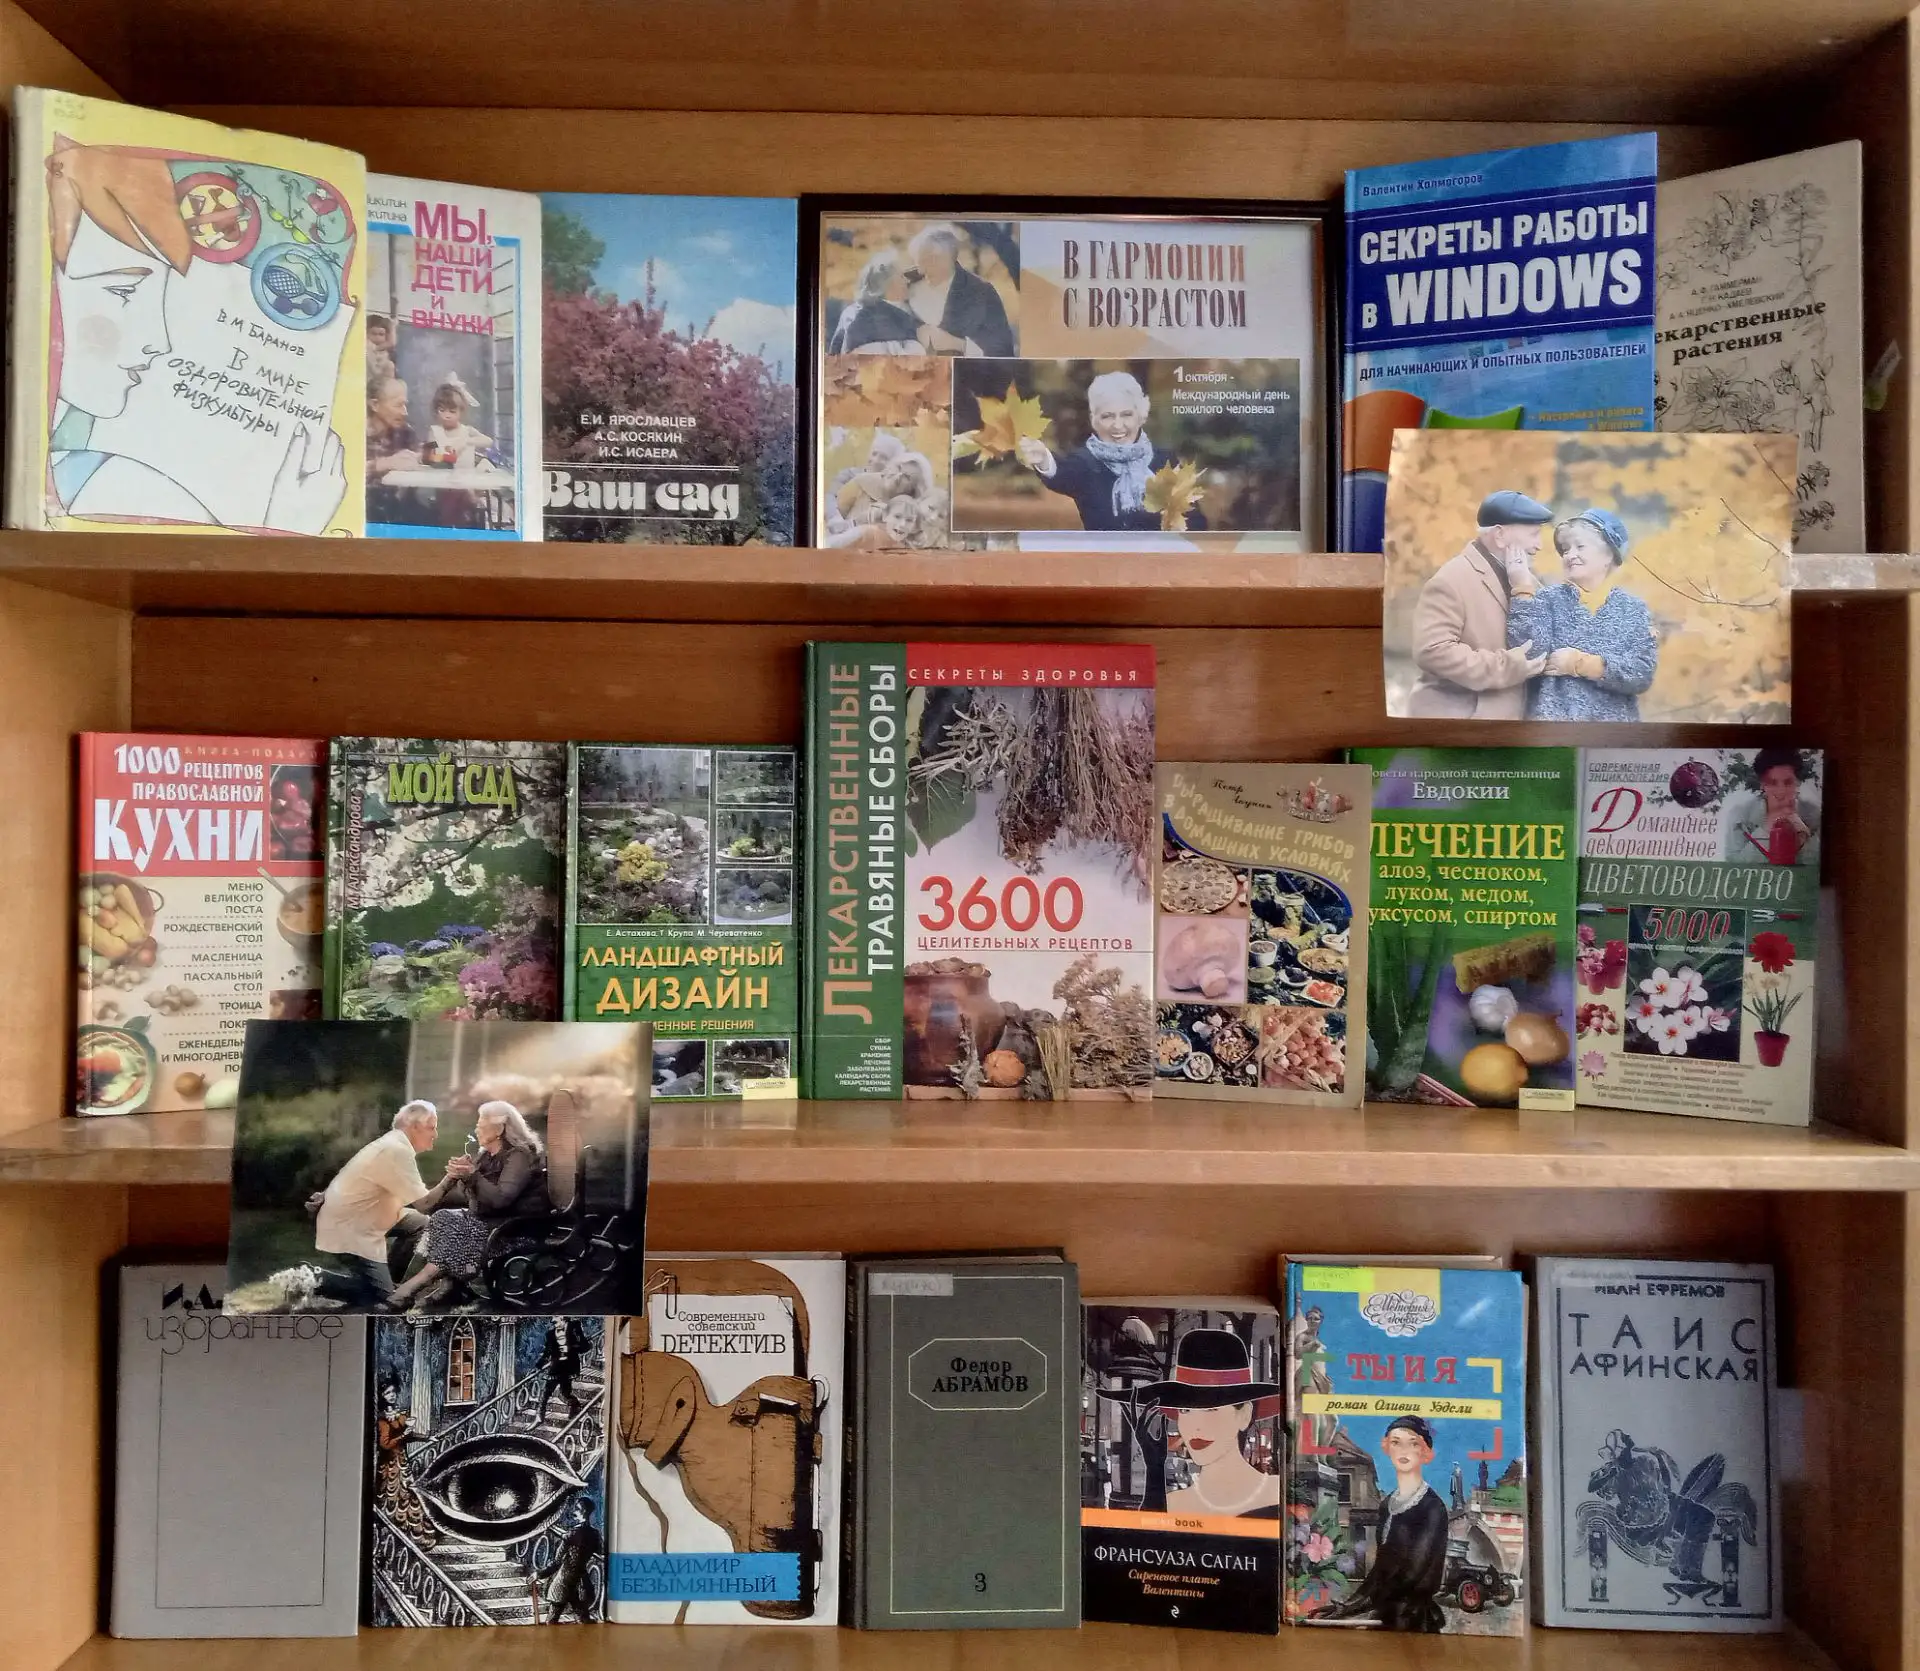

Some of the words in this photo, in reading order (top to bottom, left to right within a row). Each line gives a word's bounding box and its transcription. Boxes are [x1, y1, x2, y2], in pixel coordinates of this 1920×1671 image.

[1362, 183, 1414, 197] Валентин
[414, 200, 493, 245] МЫ,
[1359, 217, 1502, 264] СЕКРЕТЫ
[1512, 201, 1648, 247] РАБОТЫ
[414, 240, 494, 268] НАШИ
[1063, 240, 1080, 280] В
[1088, 240, 1245, 283] ГАРМОНИИ
[411, 264, 494, 295] ДЕТИ
[1385, 248, 1643, 327] WINDOWS
[1062, 287, 1078, 328] С
[1088, 287, 1247, 328] ВОЗРАСТОМ
[411, 309, 494, 336] ВНУКИ
[248, 322, 306, 357] БАРАНОВ
[1673, 331, 1783, 366] растения
[226, 347, 249, 371] В
[1360, 367, 1384, 382] ДЛЯ
[1386, 360, 1468, 379] НАЧИНАЮЩИХ
[1482, 351, 1543, 369] ОПЫТНЫХ
[1545, 343, 1647, 364] ПОЛЬЗОВАТЕЛЕЙ
[1172, 389, 1262, 402] Международный
[1263, 390, 1291, 402] день
[580, 413, 606, 427] Е.И.
[608, 414, 697, 429] ЯРОСЛАВЦЕВ
[1172, 404, 1223, 416] пожилого
[1226, 404, 1275, 415] человека
[598, 446, 624, 458] И.С.
[542, 470, 647, 511] Ваш
[655, 481, 740, 521] сад
[909, 669, 1004, 681] СЕКРЕТЫ
[1021, 669, 1138, 683] ЗДОРОВЬЯ
[868, 664, 896, 789] СБОРЫ
[114, 743, 181, 775] 1000
[183, 763, 264, 781] РЕЦЕПТОВ
[1588, 762, 1661, 772] СОВРЕМЕННАЯ
[387, 751, 454, 804] МОЙ
[464, 764, 518, 810] САД
[1412, 782, 1510, 801] Евдокии
[132, 781, 264, 803] ПРАВОСЛАВНОЙ
[1588, 786, 1718, 834] Домашнее
[95, 799, 264, 872] КУХНИ
[823, 664, 873, 1025] ЛЕКАРСТВЕННЫЕ
[1294, 827, 1355, 860] ГРИБОВ
[1585, 834, 1717, 858] декоративное
[867, 794, 896, 976] ТРАВЯНЫЕ
[1379, 864, 1432, 882] алоэ,
[1437, 866, 1548, 886] чесноком,
[1584, 862, 1794, 902] ЦВЕТОВОДСТВО
[204, 894, 264, 903] ВЕЛИКОГО
[228, 883, 264, 892] МЕНЮ
[1385, 887, 1454, 906] луком,
[1460, 887, 1534, 907] медом,
[225, 905, 264, 914] ПОСТА
[918, 875, 1084, 932] 3600
[163, 920, 264, 933] РОЖДЕСТВЕНСКИЙ
[1369, 907, 1458, 927] уксусом,
[1464, 909, 1558, 930] спиртом
[1642, 907, 1731, 943] 5000
[235, 934, 263, 943] СТОЛ
[708, 929, 763, 938] Череватенко
[918, 936, 1039, 950] ЦЕЛИТЕЛЬНЫХ
[1049, 938, 1133, 951] РЕЦЕПТОВ
[191, 953, 263, 963] МАСЛЕНИЦА
[582, 941, 784, 968] ЛАНДШАФТНЫЙ
[184, 971, 263, 982] ПАСХАЛЬНЫЙ
[234, 982, 263, 992] СТОЛ
[596, 968, 769, 1015] ДИЗАЙН
[219, 1001, 263, 1011] ТРОИЦА
[701, 1020, 754, 1030] РЕШЕНИЯ
[161, 1054, 170, 1063] И
[1646, 1283, 1725, 1298] ЕФРЕМОВ
[145, 1308, 344, 1355] избранное
[1568, 1312, 1758, 1355] ТАИС
[950, 1357, 1012, 1376] Федор
[1347, 1353, 1397, 1382] ТЫ
[1404, 1355, 1427, 1383] И
[1433, 1356, 1458, 1384] Я
[1569, 1352, 1759, 1382] АФИНСКАЯ
[932, 1376, 1029, 1392] АБРАМОВ
[1325, 1401, 1368, 1412] роман
[1374, 1399, 1421, 1412] Оливии
[622, 1558, 741, 1577] ВЛАДИМИР
[1094, 1545, 1196, 1567] ФРАНСУАЗА
[1201, 1553, 1257, 1571] САГАН
[621, 1574, 777, 1594] БЕЗЫМЯННЫЙ
[974, 1572, 987, 1592] 3
[1128, 1569, 1181, 1583] Сиреневое
[1181, 1574, 1221, 1586] платье
[1142, 1584, 1205, 1599] Валентины
